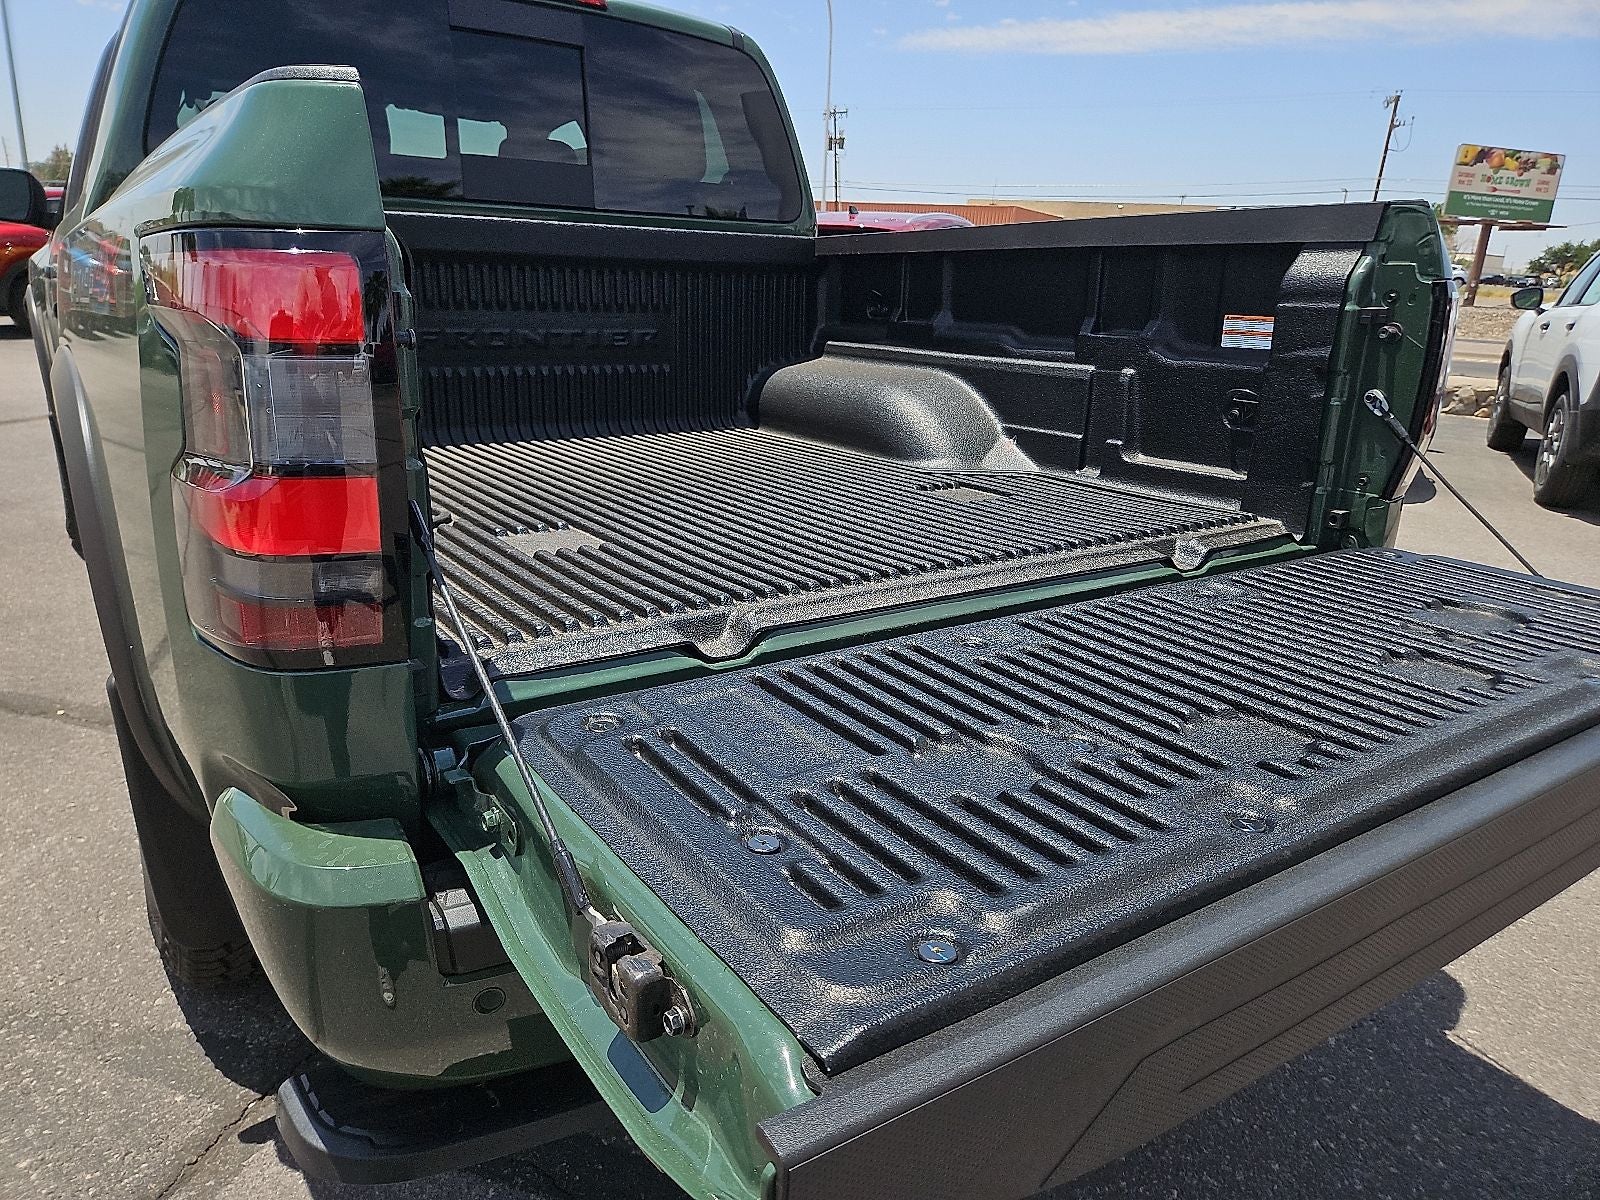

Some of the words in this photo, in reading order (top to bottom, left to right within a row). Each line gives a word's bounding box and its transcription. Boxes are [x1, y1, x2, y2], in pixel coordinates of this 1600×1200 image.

[1480, 174, 1502, 185] HOME
[1505, 176, 1532, 188] GROWN
[417, 329, 658, 346] FRONTIER
